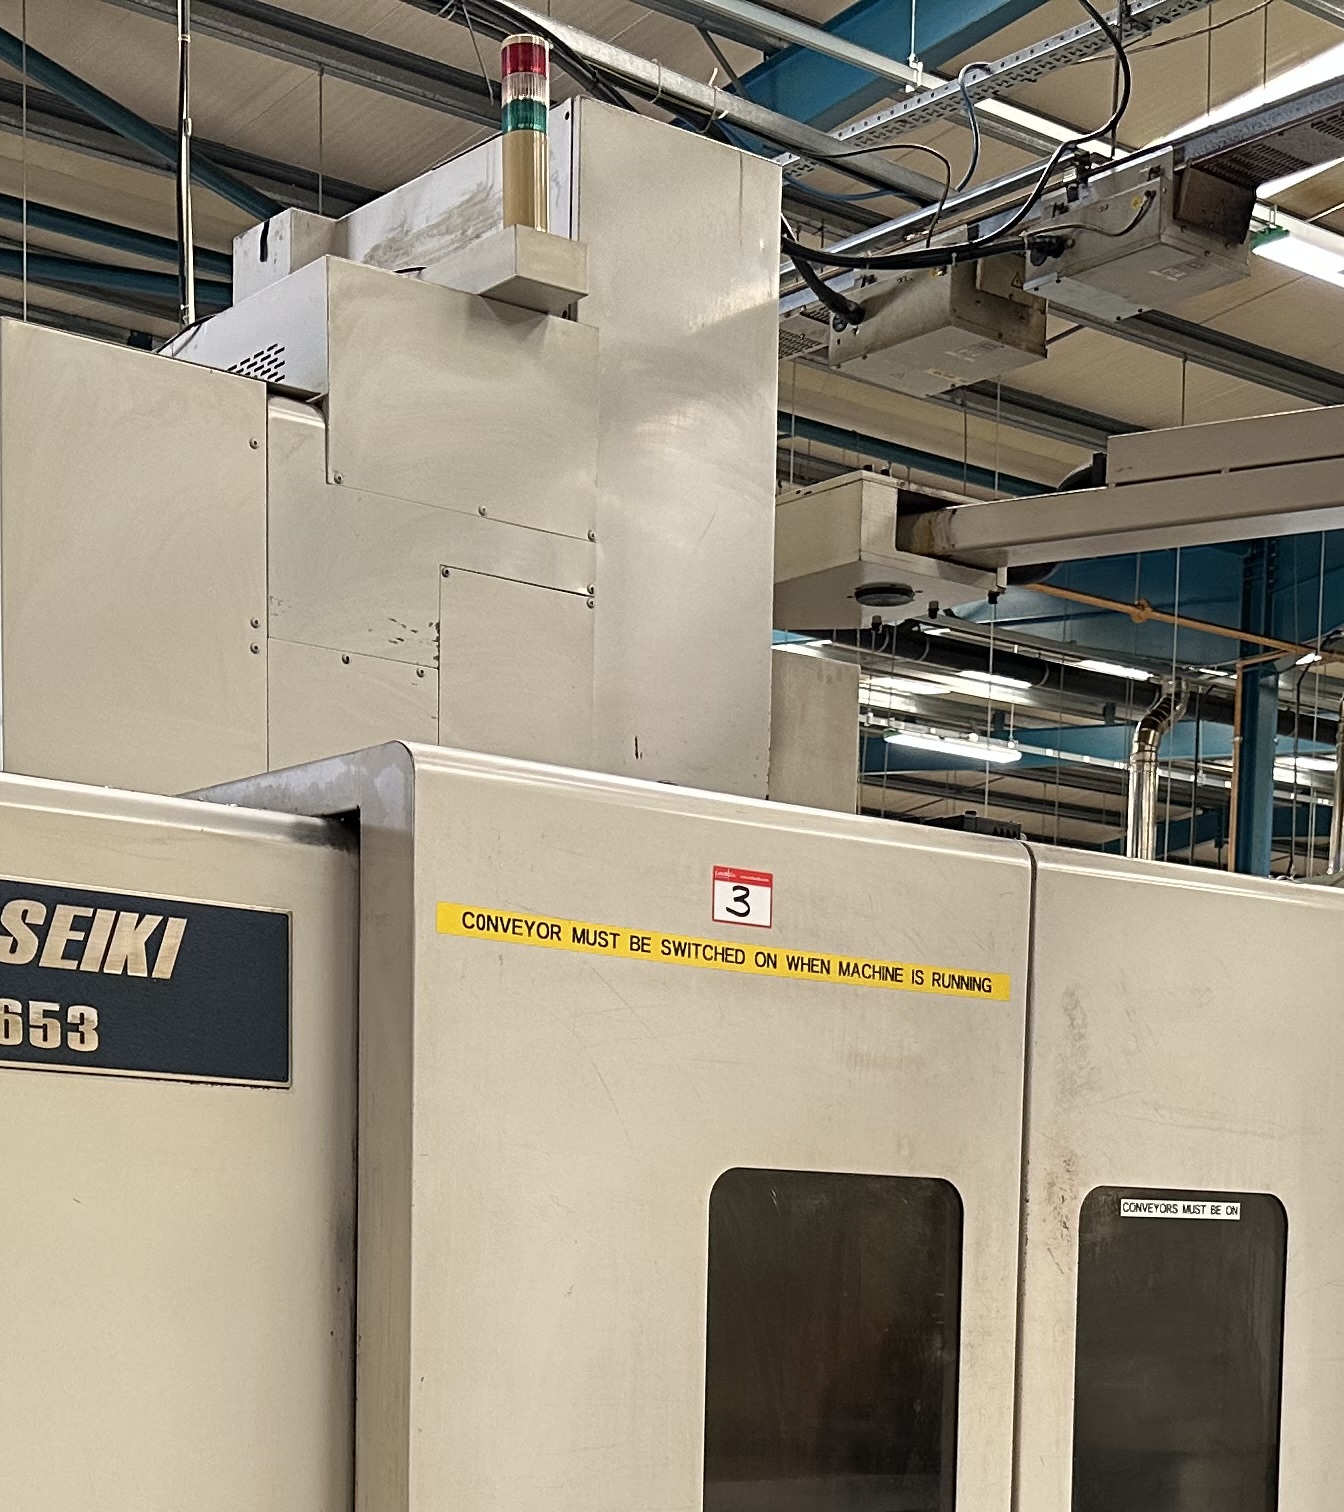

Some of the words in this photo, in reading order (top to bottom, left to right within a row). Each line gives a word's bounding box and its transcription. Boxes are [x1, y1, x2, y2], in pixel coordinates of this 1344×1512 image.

[726, 885, 751, 917] 3
[462, 911, 561, 941] CONVEYOR
[572, 926, 620, 949] MUST
[630, 935, 651, 953] BE
[661, 939, 745, 965] SWITCHED
[755, 951, 777, 969] ON
[786, 955, 831, 975] WHEN
[838, 961, 904, 983] MACHINE
[911, 969, 924, 985] IS
[931, 972, 992, 993] RUNNING
[1123, 1202, 1178, 1214] CONVEYORS
[1183, 1204, 1206, 1215] MUST
[1210, 1206, 1221, 1215] BE
[1226, 1206, 1238, 1216] ON
